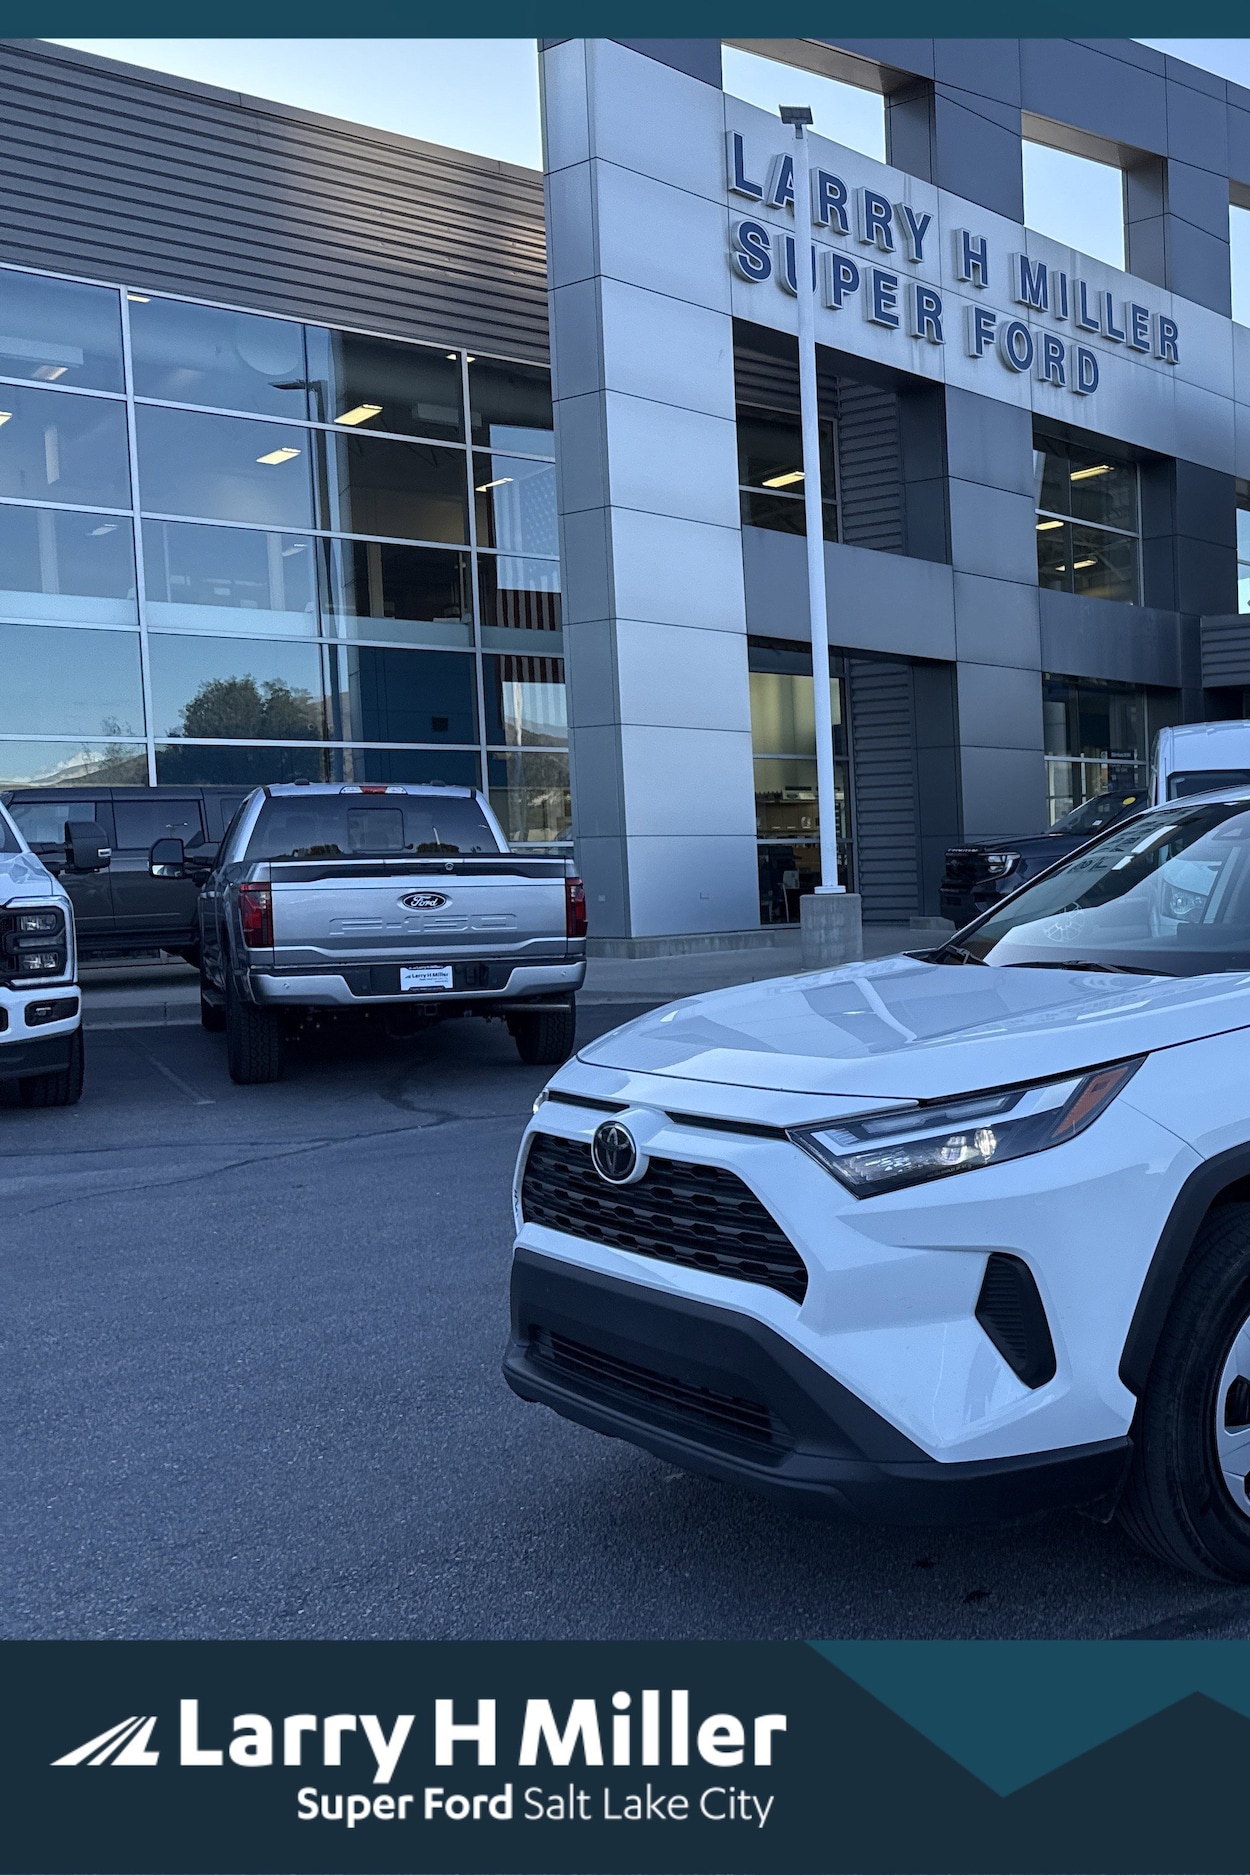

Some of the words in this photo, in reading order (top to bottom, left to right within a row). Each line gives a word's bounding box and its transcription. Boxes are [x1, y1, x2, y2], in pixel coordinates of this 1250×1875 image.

[728, 130, 934, 263] LARRY
[955, 228, 989, 289] H
[1013, 252, 1180, 365] MILLER
[732, 220, 945, 345] SUPER
[967, 304, 1100, 396] FORD
[329, 913, 518, 936] F-150
[410, 895, 439, 907] Ford
